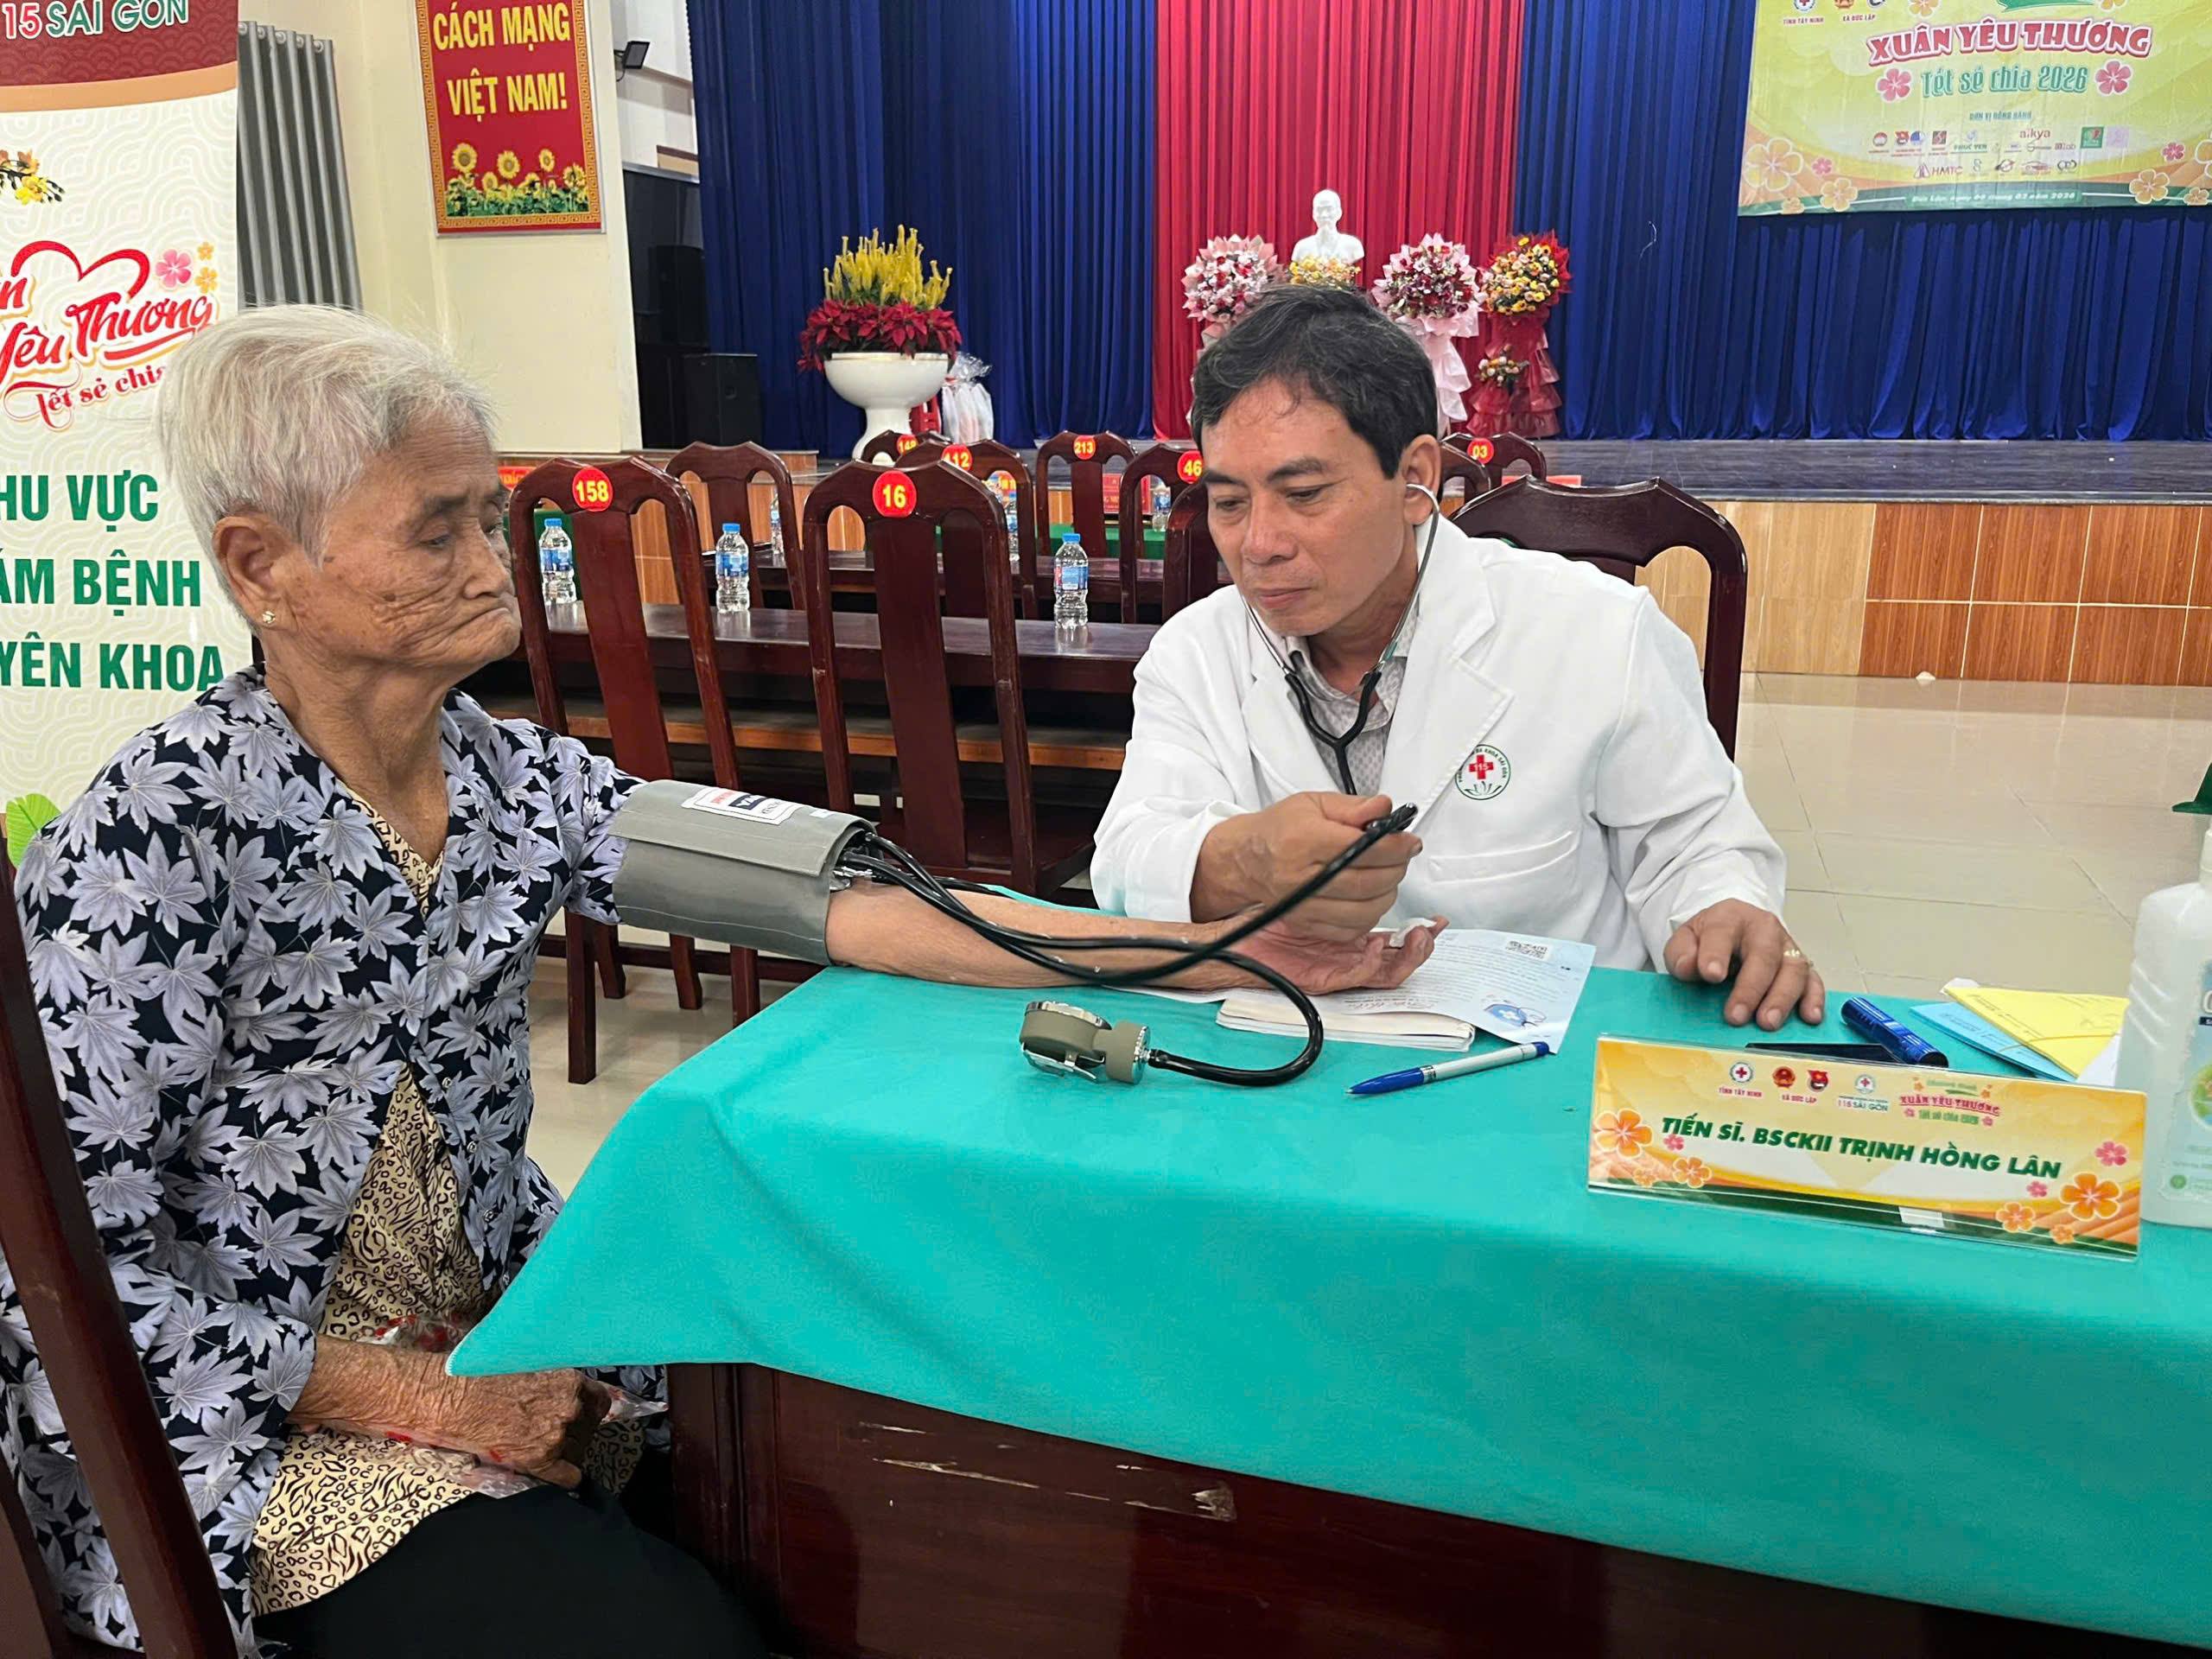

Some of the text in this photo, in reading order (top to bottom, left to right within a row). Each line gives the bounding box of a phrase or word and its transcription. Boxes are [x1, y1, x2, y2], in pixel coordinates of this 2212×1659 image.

[434, 2, 571, 51] CÁCH MẠNG
[1868, 16, 2152, 66] XUÂN YÊU THƯƠNG
[447, 67, 568, 123] VIỆT NAM!
[1990, 64, 2031, 92] chia
[2037, 65, 2088, 92] 2026
[66, 292, 213, 357] Thương
[1074, 442, 1093, 454] 213
[1182, 460, 1203, 477] 46
[67, 470, 158, 532] VỰC
[575, 480, 609, 503] 158
[882, 484, 906, 509] 16
[73, 550, 201, 616] BỆNH
[99, 643, 225, 692] KHOA
[1662, 1112, 1713, 1138] TIẾN
[1751, 1127, 1833, 1152] BSCKII
[1839, 1137, 1915, 1163] TRỊNH
[2007, 1154, 2062, 1179] LÂN
